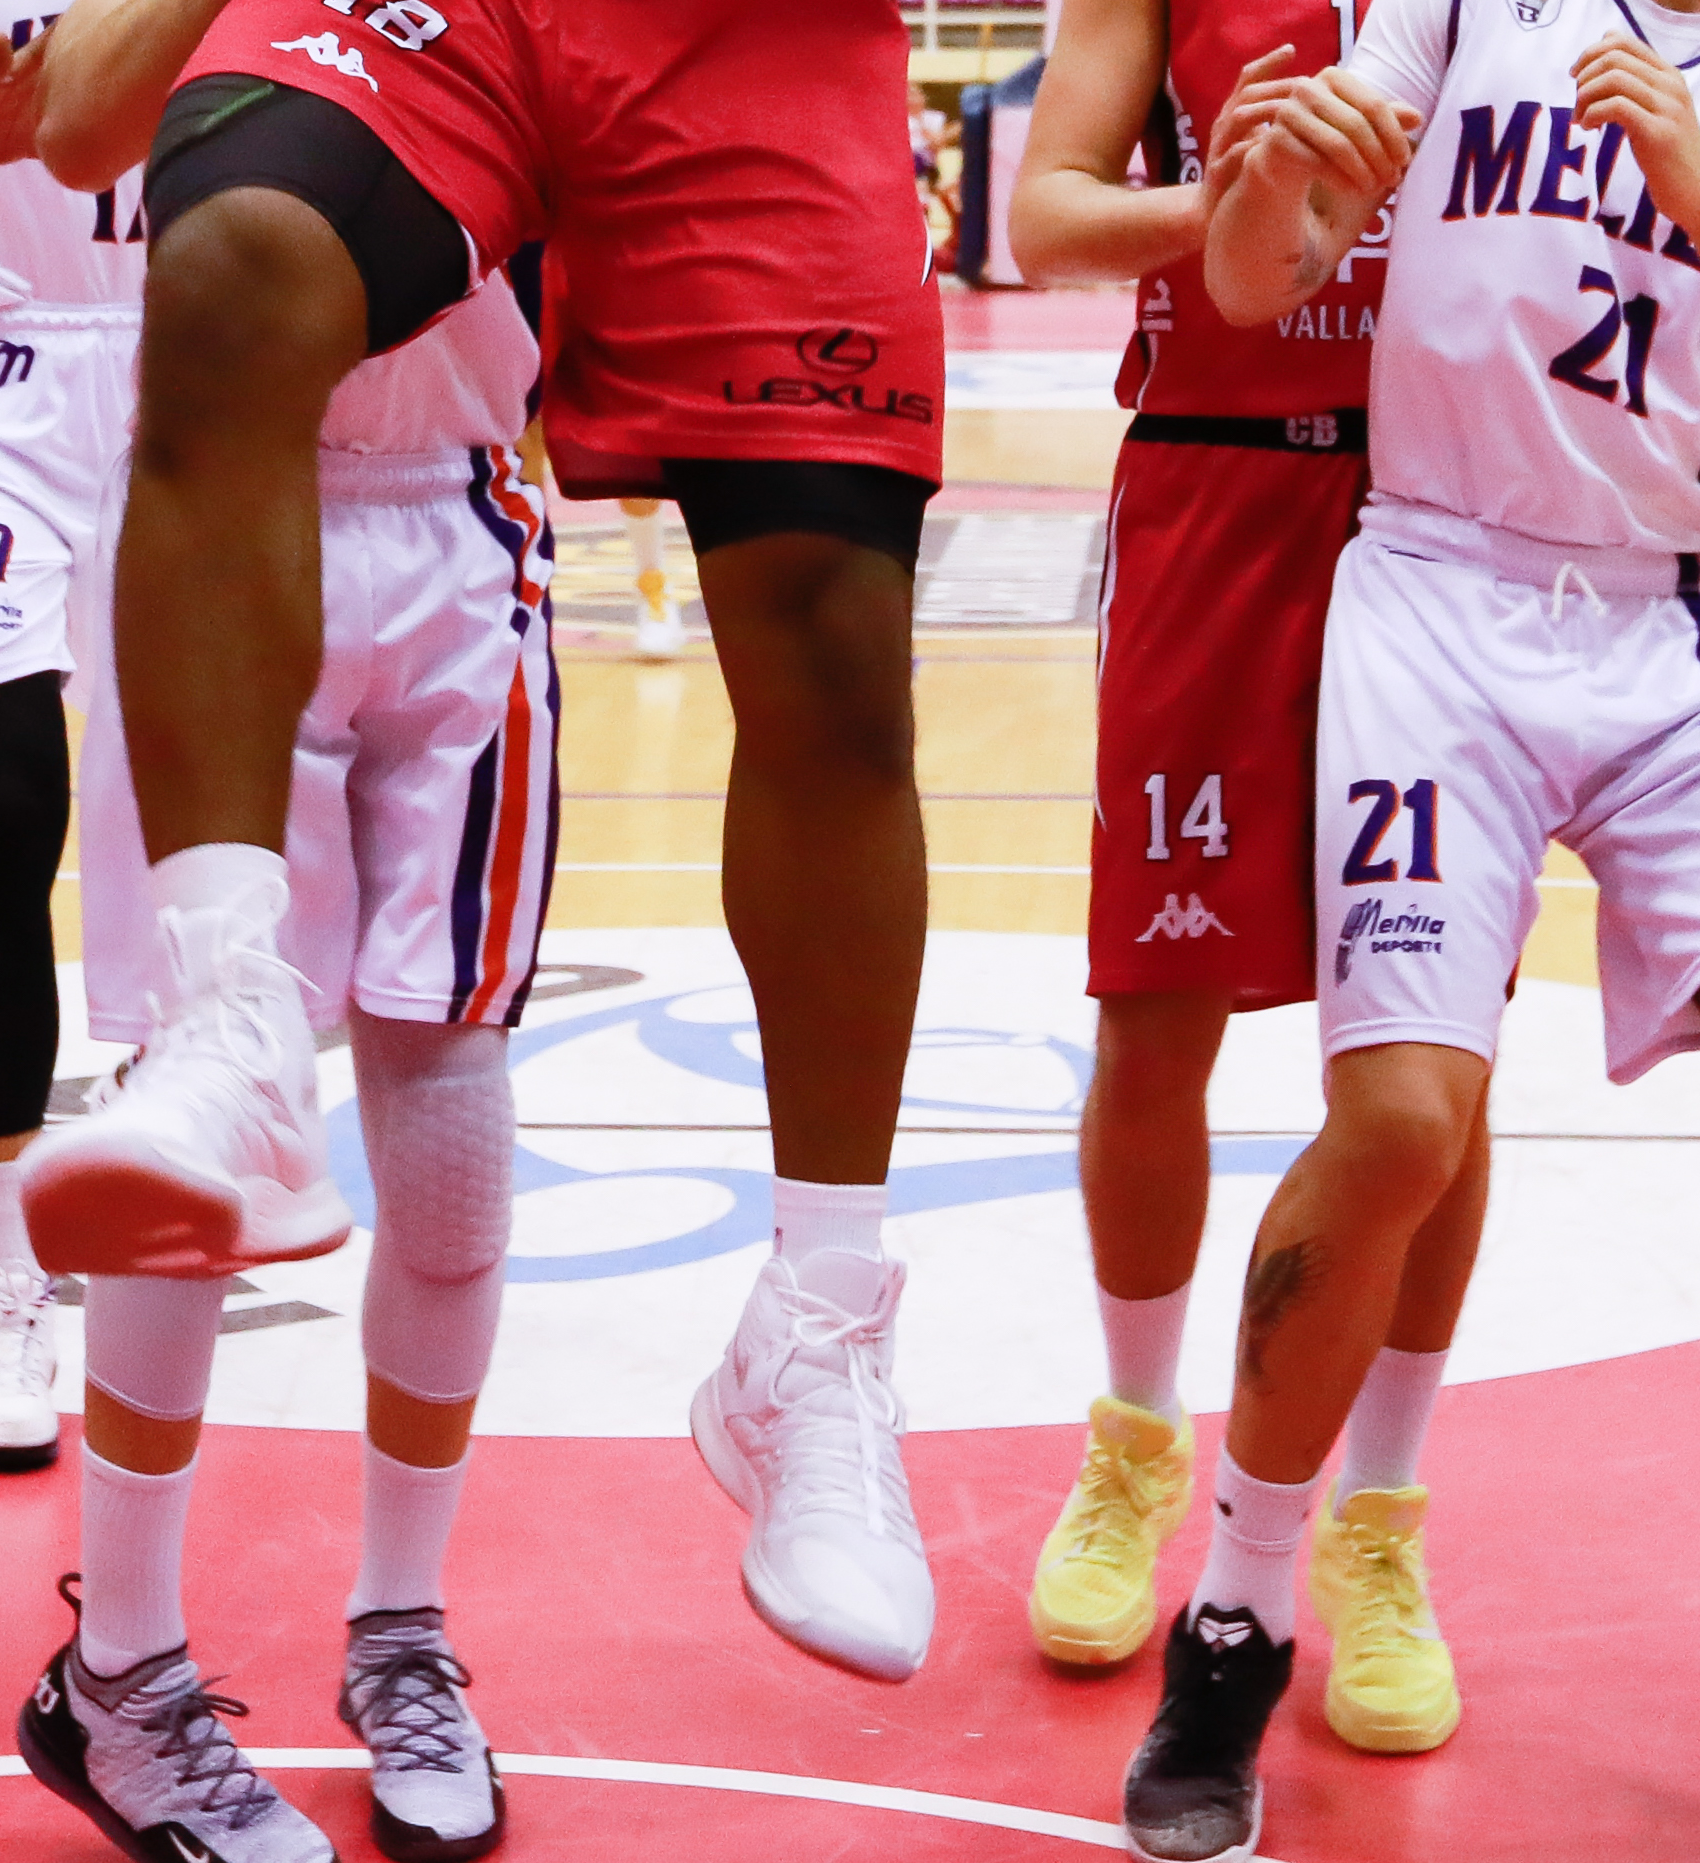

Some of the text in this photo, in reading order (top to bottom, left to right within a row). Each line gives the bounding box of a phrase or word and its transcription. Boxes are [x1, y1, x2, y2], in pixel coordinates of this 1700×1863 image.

[1548, 264, 1662, 419] 21
[722, 376, 935, 426] LEXUS
[1285, 413, 1339, 448] CB
[1143, 772, 1232, 862] 14
[1339, 777, 1444, 888] 21
